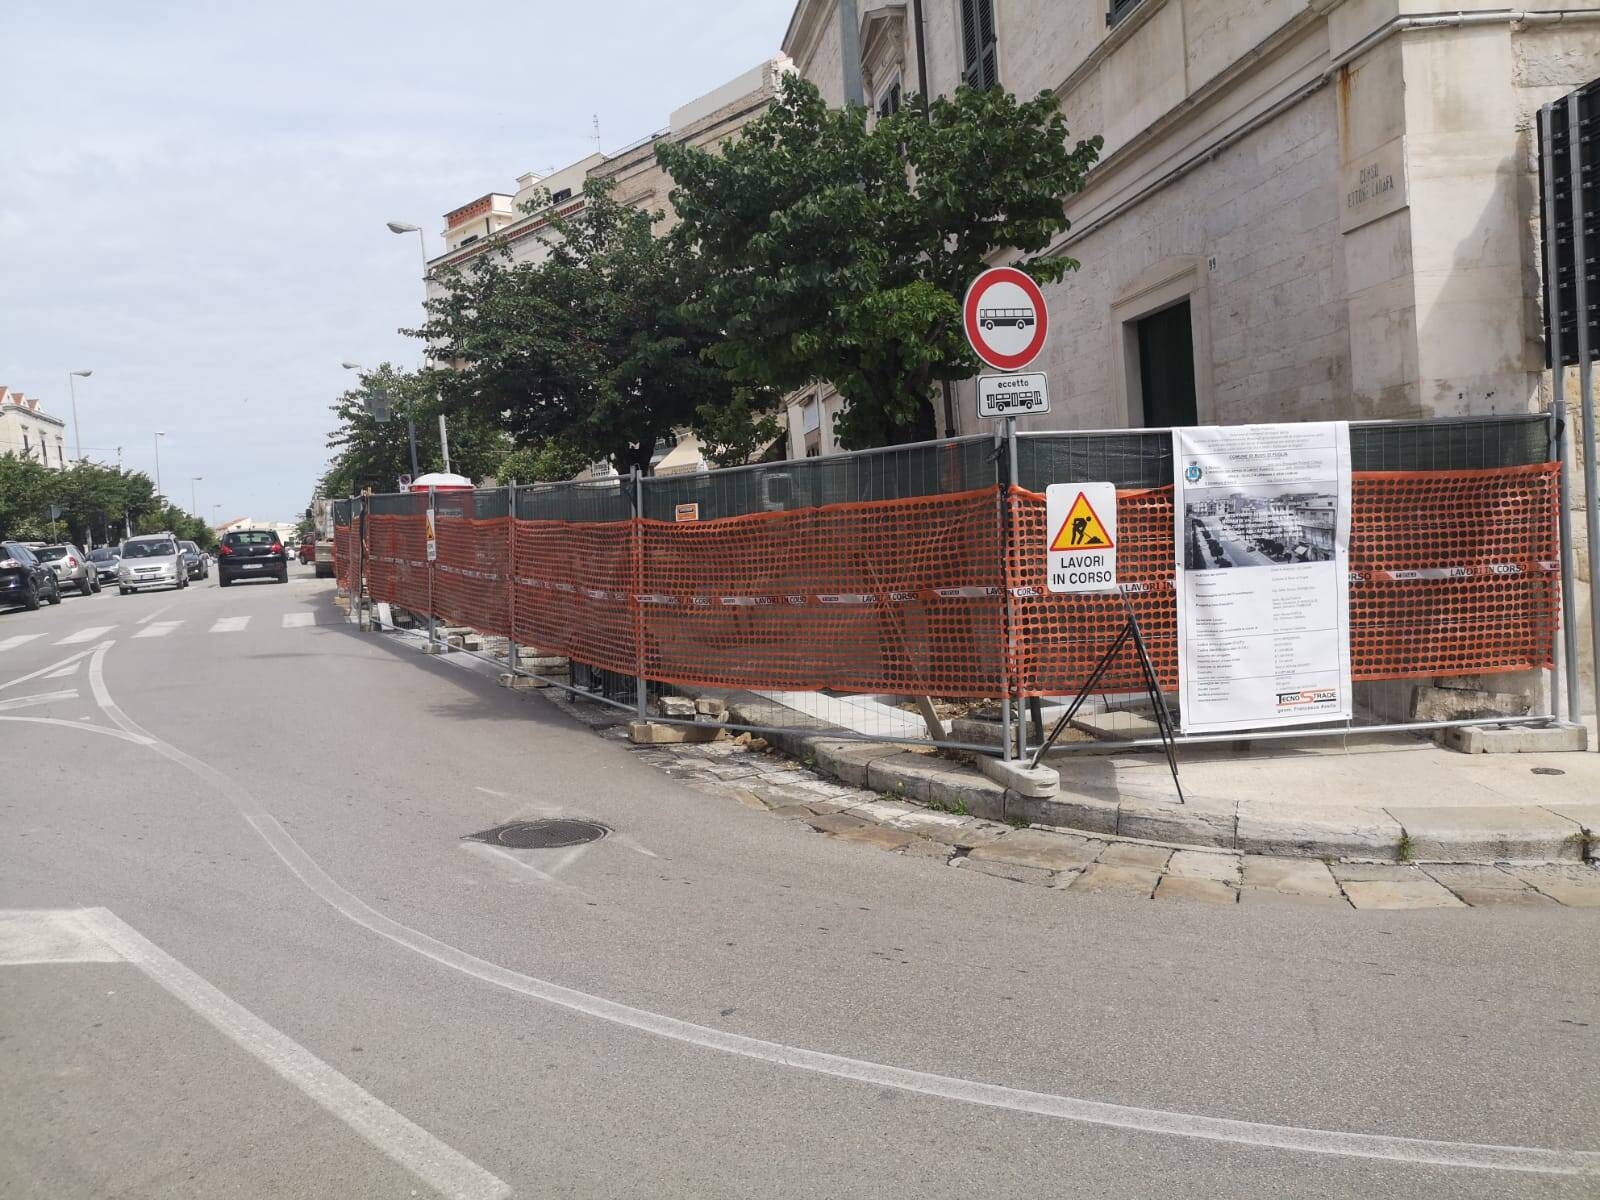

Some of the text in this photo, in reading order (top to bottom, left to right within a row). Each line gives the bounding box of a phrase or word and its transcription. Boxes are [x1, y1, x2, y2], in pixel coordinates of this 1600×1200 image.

[997, 379, 1029, 389] eccetto
[1061, 556, 1104, 569] LAVORI
[1450, 564, 1527, 577] LAVORI IN CORSO
[1053, 571, 1112, 585] IN CORSO
[1017, 586, 1044, 597] CORSO
[1125, 581, 1174, 592] LAVORI IN
[892, 592, 919, 601] CORSO
